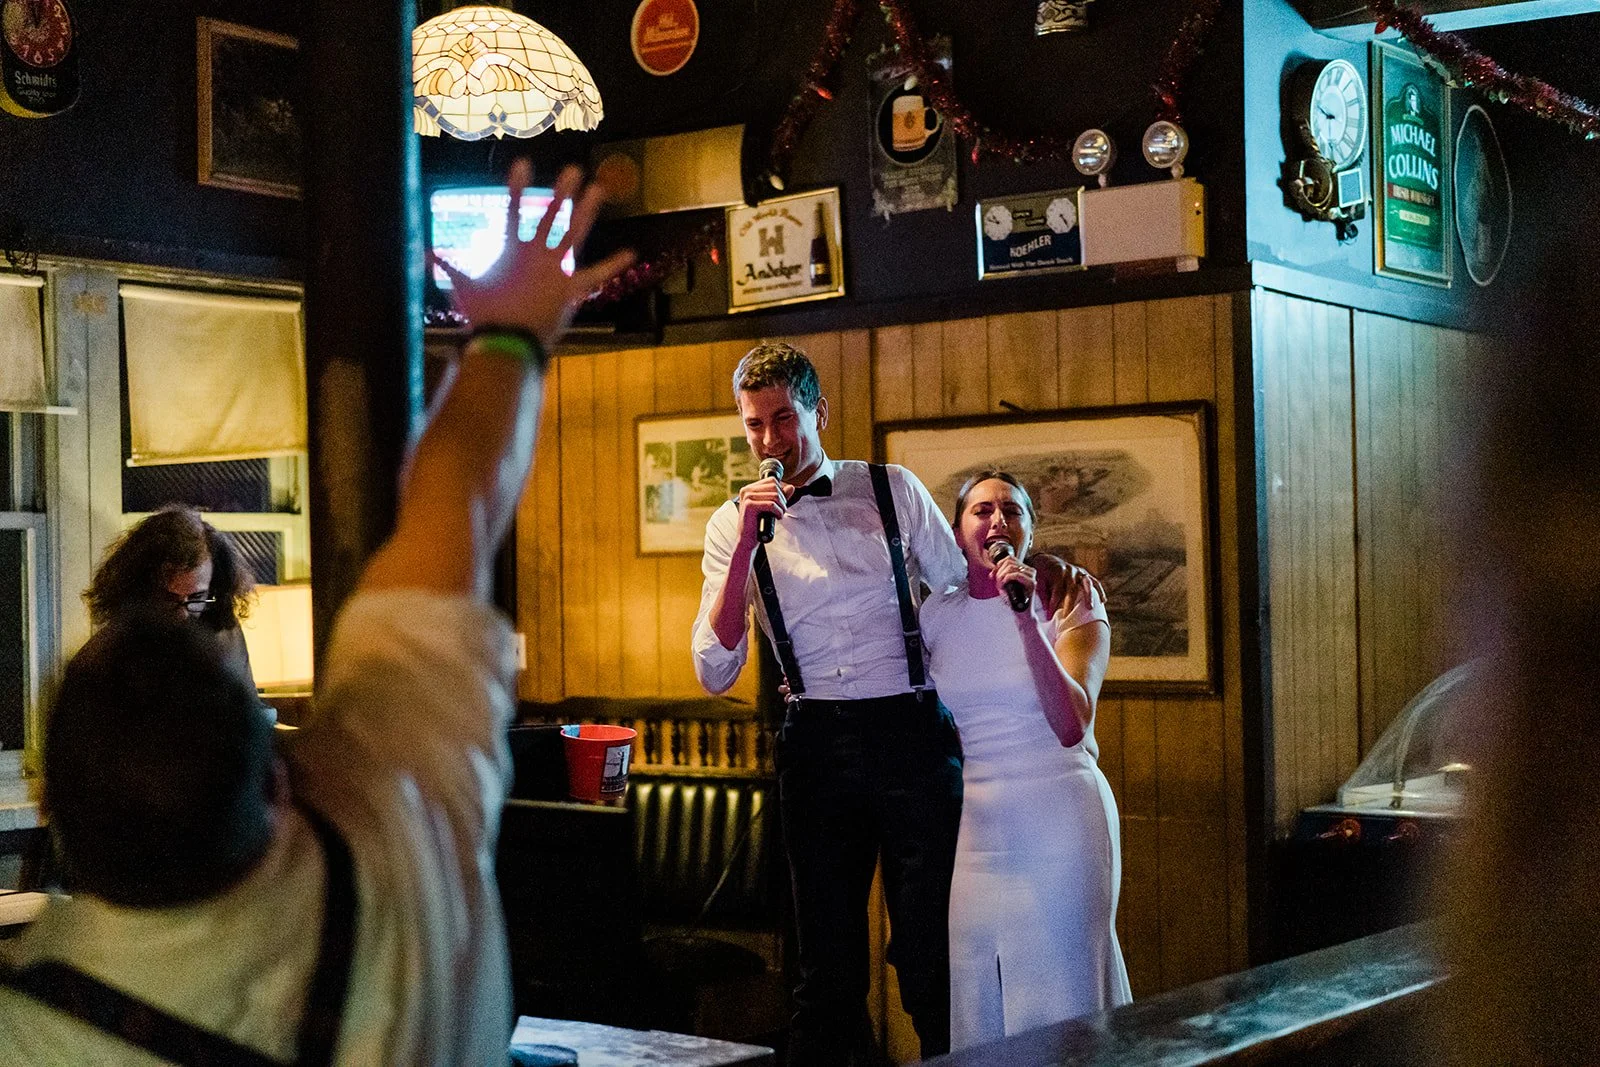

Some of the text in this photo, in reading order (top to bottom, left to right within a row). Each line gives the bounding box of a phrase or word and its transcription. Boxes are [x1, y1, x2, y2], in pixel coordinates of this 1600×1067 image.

[33, 50, 43, 64] 6
[1390, 124, 1436, 158] MICHAEL
[1389, 154, 1438, 190] COLLINS
[758, 224, 785, 257] H
[1010, 235, 1051, 257] KOEHLER
